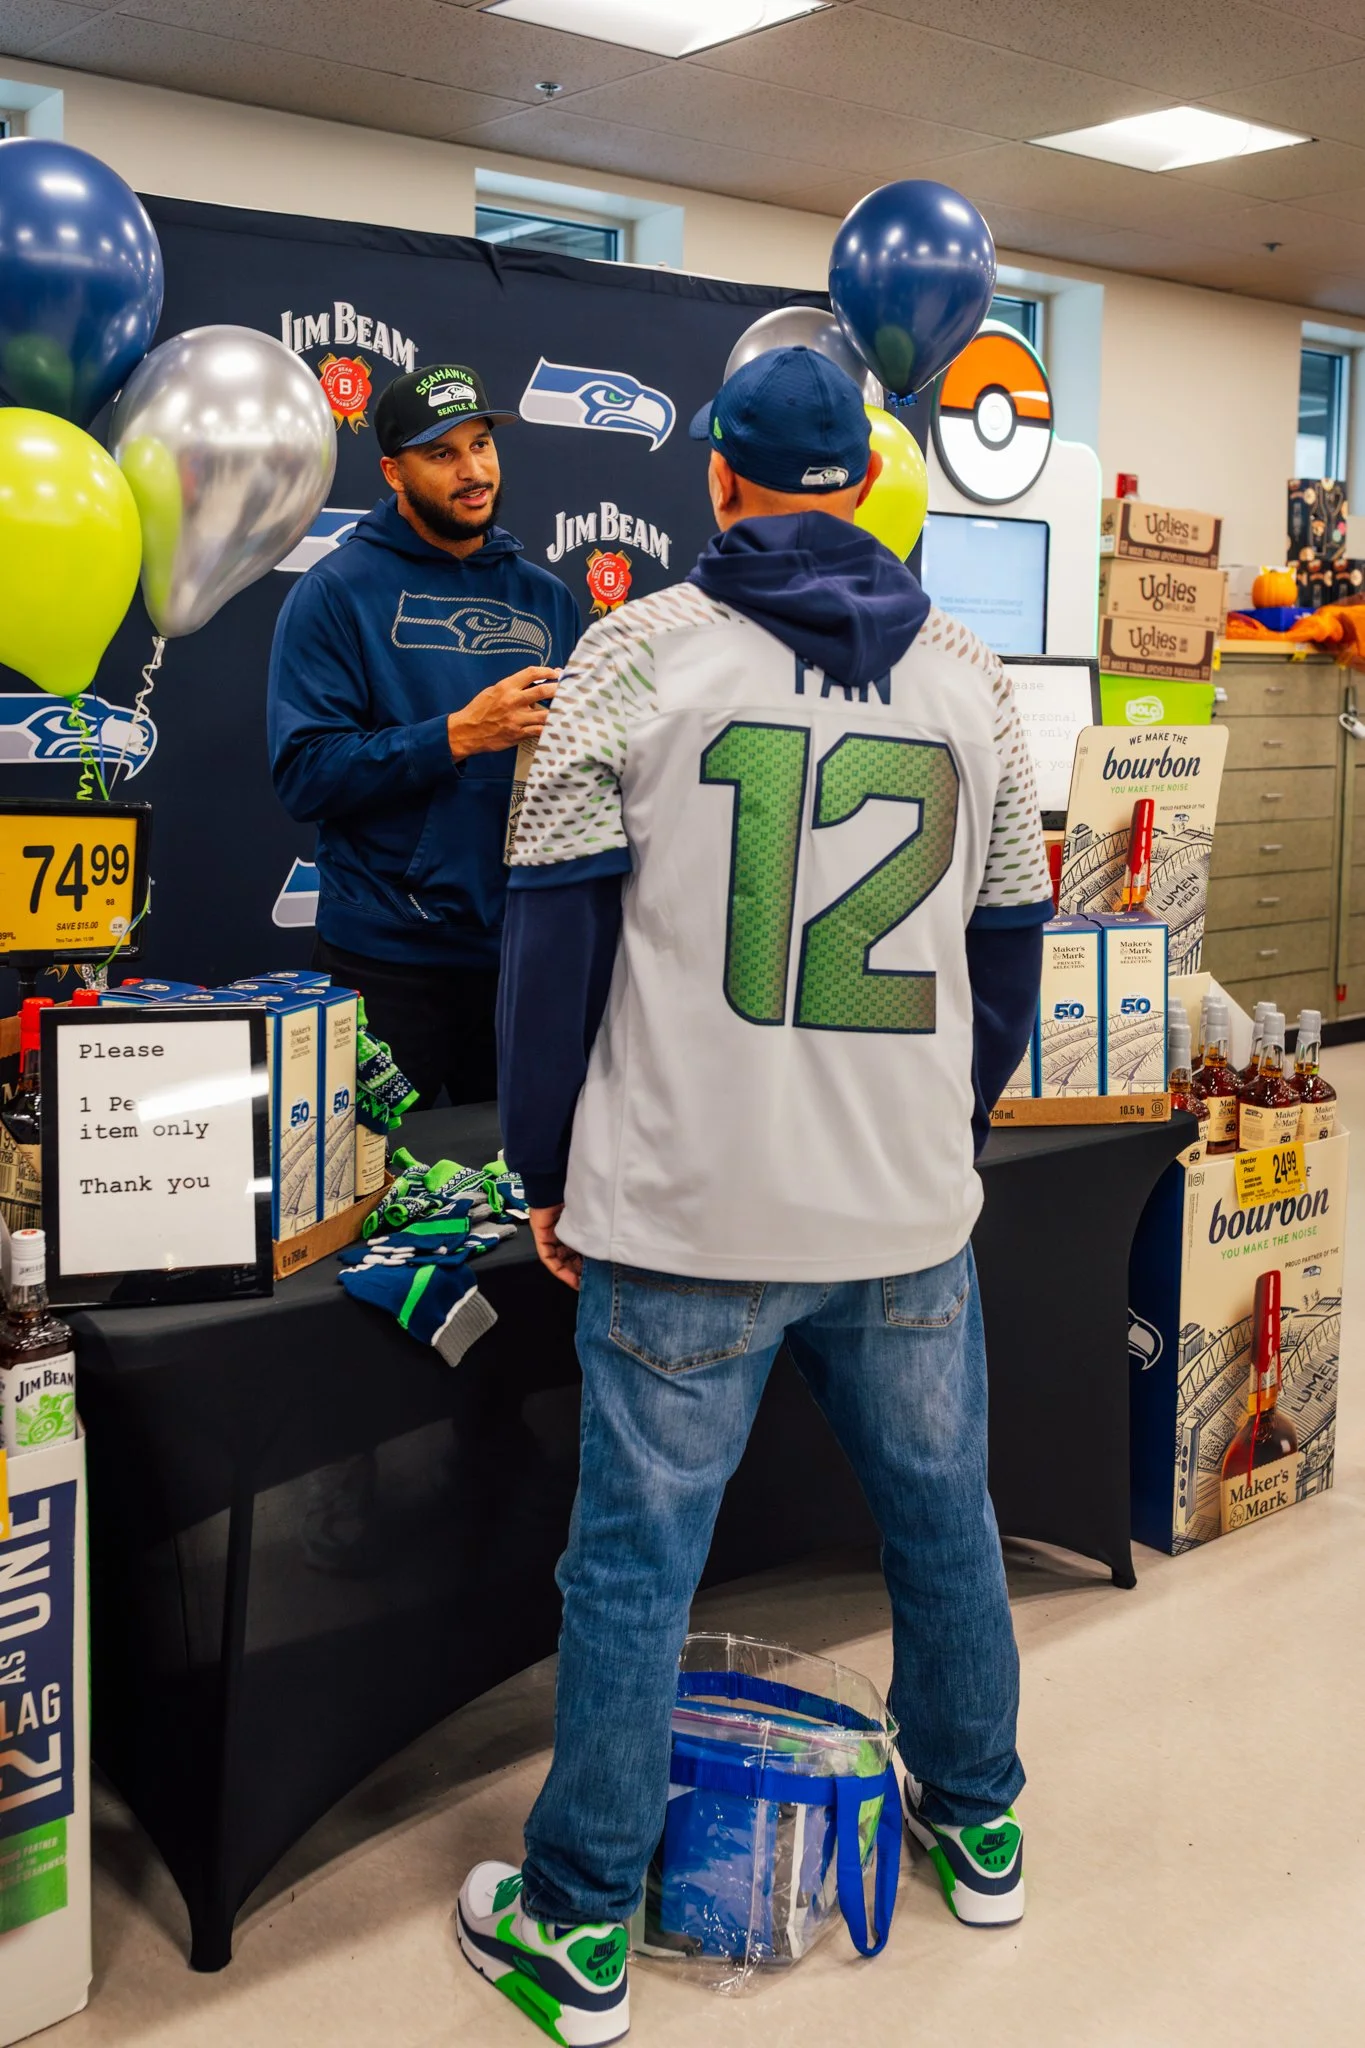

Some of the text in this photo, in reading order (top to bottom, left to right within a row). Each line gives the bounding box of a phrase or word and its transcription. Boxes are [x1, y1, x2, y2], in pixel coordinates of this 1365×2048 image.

[281, 301, 416, 374] JIM BEAM
[339, 378, 352, 395] B
[416, 368, 474, 396] SEAHAWKS
[437, 403, 468, 417] SEATTLE,
[546, 502, 670, 570] JIM BEAM
[1145, 512, 1190, 544] Uglies
[604, 572, 615, 586] B
[1139, 573, 1197, 612] Uglies
[1128, 626, 1177, 656] Uglies
[1014, 681, 1045, 690] ease
[1040, 727, 1071, 741] only
[1129, 732, 1188, 746] WE MAKE THE
[1102, 745, 1201, 780] bourbon
[1110, 783, 1188, 794] YOU MAKE THE NOISE
[700, 720, 960, 1034] 12
[1157, 872, 1200, 912] LUMEN
[1176, 886, 1200, 908] FIELD
[106, 898, 115, 906] ea
[56, 922, 98, 931] SAVE $15.00
[1054, 1002, 1085, 1020] 50
[1120, 997, 1152, 1014] 50
[80, 1043, 164, 1059] Please
[81, 1097, 92, 1112] 1
[333, 1088, 350, 1113] 50
[291, 1100, 309, 1126] 50
[1120, 1106, 1144, 1116] 10.5 kg
[80, 1120, 210, 1140] item only
[1226, 1122, 1236, 1133] 50
[1319, 1130, 1328, 1140] 50
[1280, 1135, 1291, 1144] 50
[1188, 1151, 1200, 1162] 50
[1240, 1157, 1257, 1165] Member
[80, 1176, 210, 1195] Thank you
[1208, 1188, 1330, 1245] bourbon
[1220, 1226, 1318, 1260] YOU MAKE THE NOISE
[1285, 1260, 1301, 1268] PROUD
[1302, 1253, 1323, 1264] PARTNER
[15, 1376, 41, 1403] JIM
[43, 1370, 74, 1388] BEAM
[1291, 1354, 1339, 1412] LUMEN
[1316, 1368, 1338, 1402] FIELD
[1229, 1469, 1289, 1506] Maker's
[1245, 1490, 1288, 1522] Mark
[0, 1682, 60, 1742] LAG
[23, 1836, 58, 1857] PARTNER
[982, 1832, 1006, 1846] NIKE
[984, 1856, 1006, 1865] AIR
[593, 1940, 616, 1958] NIKE
[596, 1964, 617, 1980] AIR
